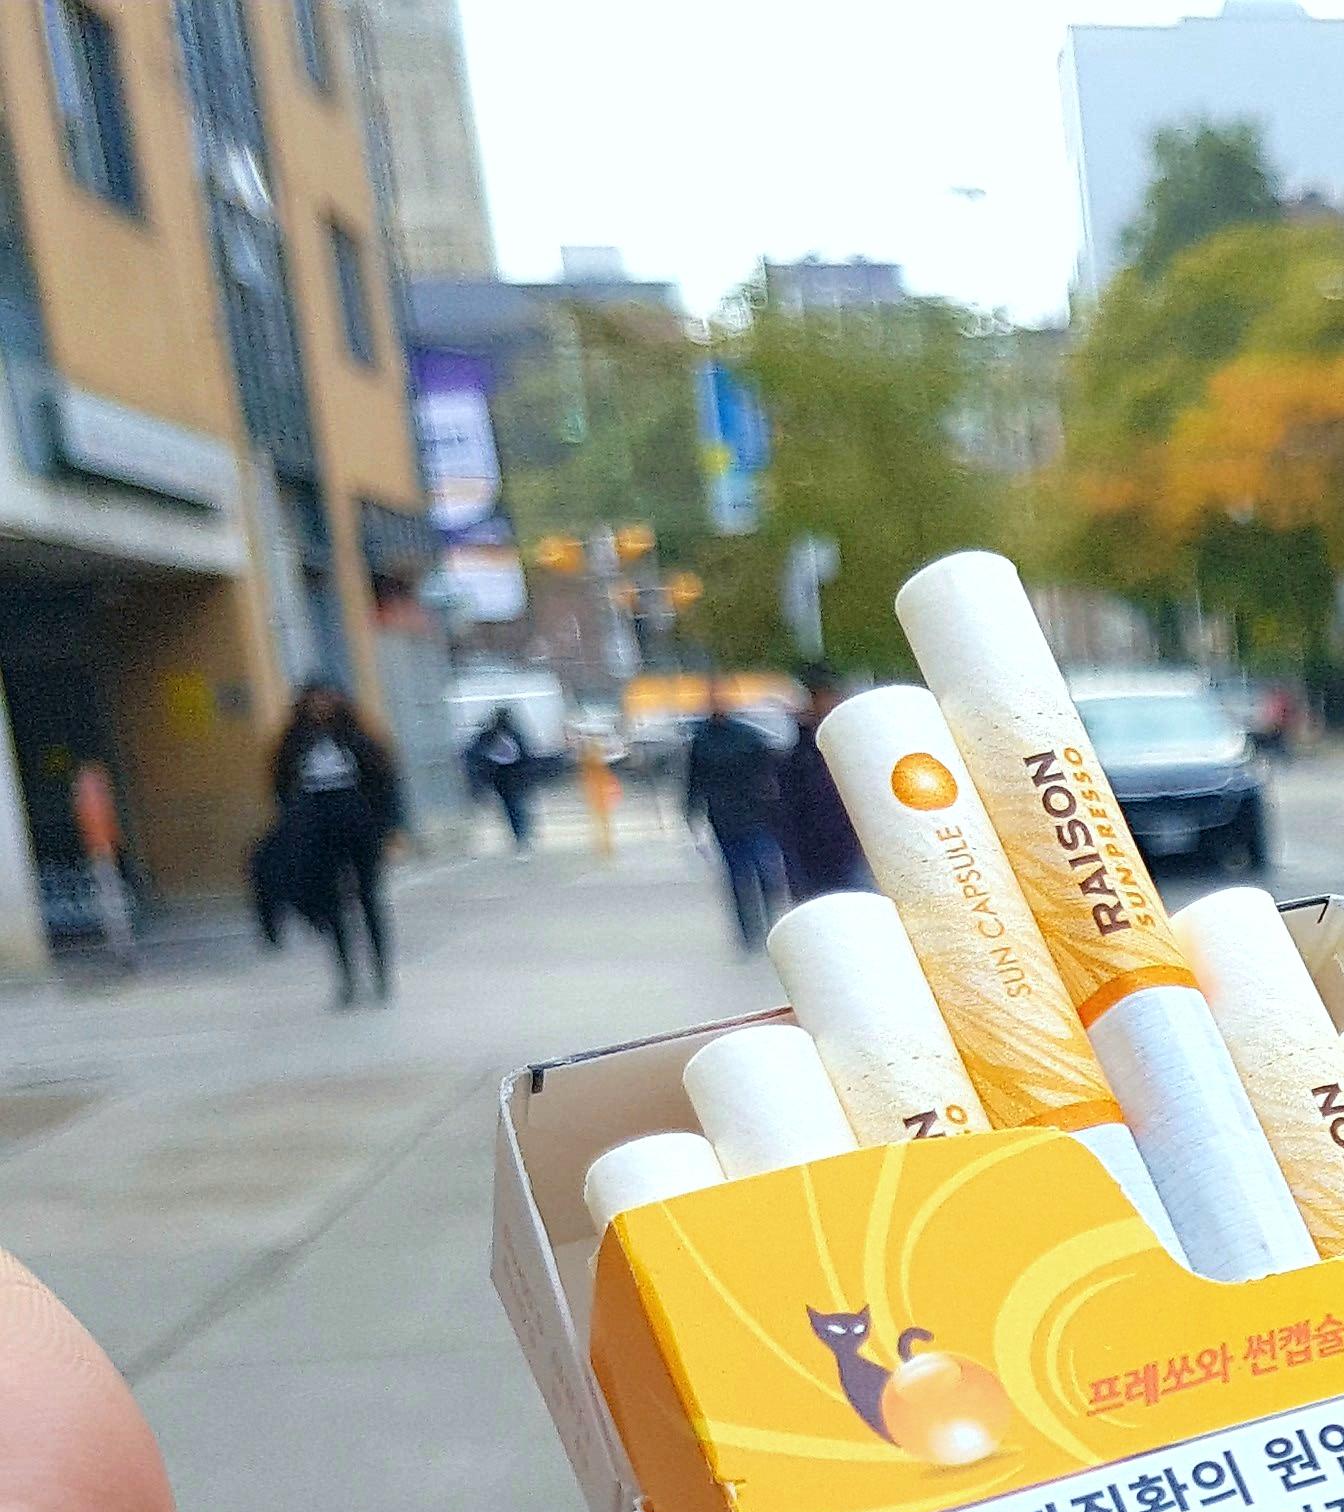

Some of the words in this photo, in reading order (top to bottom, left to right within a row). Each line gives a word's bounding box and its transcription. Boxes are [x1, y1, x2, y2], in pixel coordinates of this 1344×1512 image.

[1022, 749, 1132, 937] RAISON
[1062, 746, 1126, 858] PRESSO
[936, 825, 1006, 939] CAPSULE
[1114, 866, 1157, 929] SUN
[988, 946, 1033, 998] SUN
[1086, 1342, 1233, 1417] 프레쏘와
